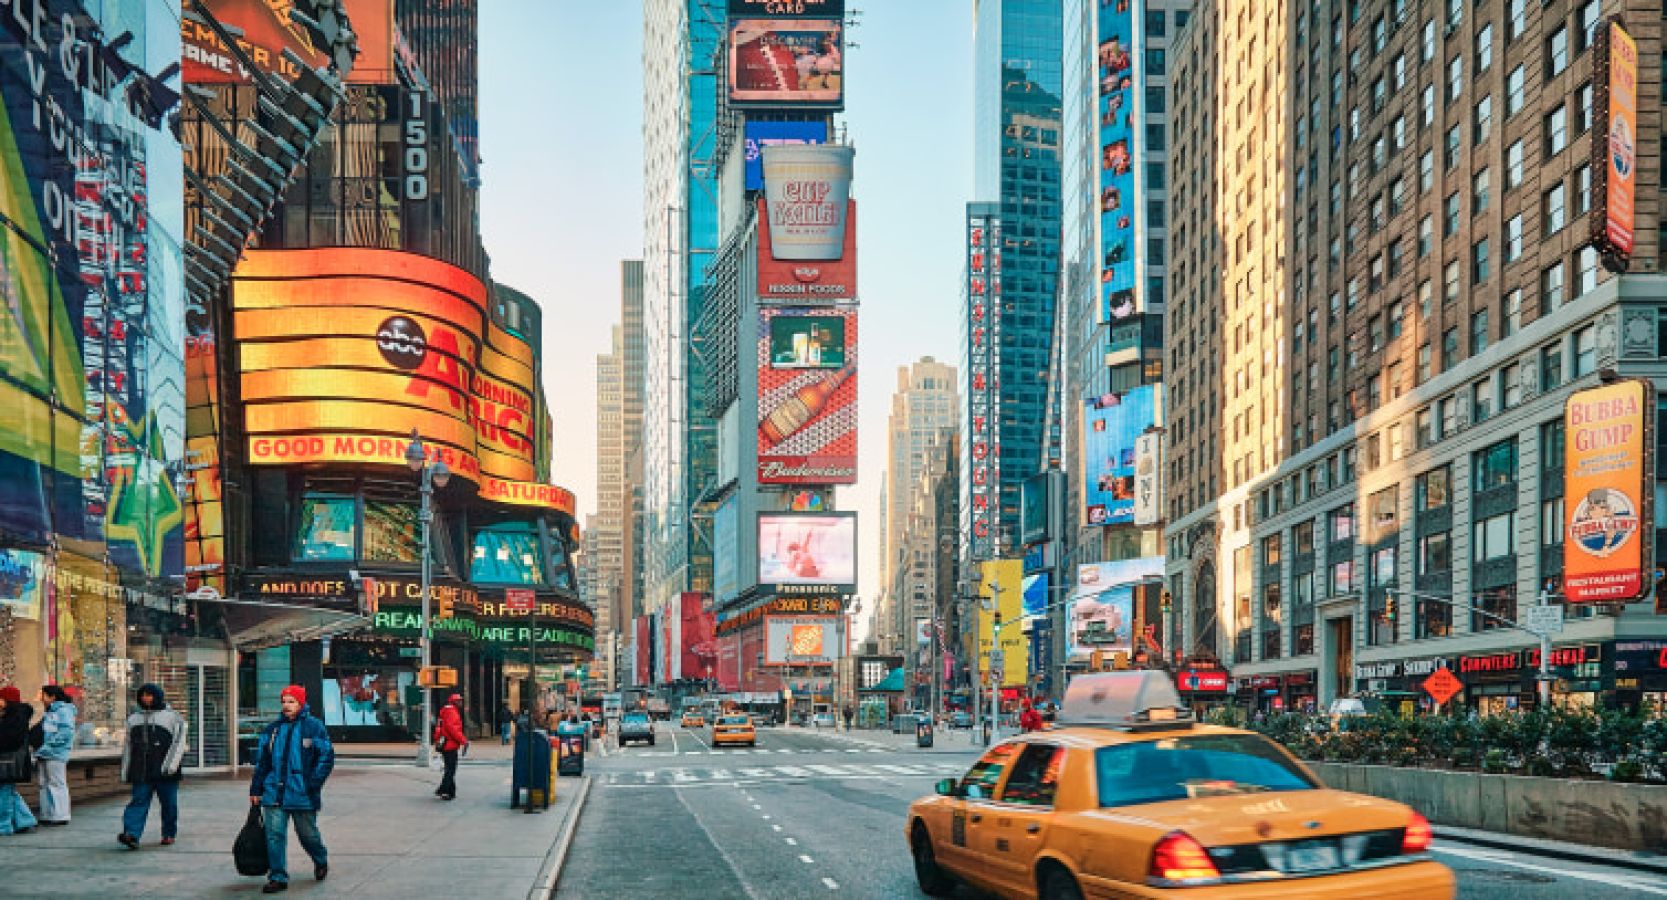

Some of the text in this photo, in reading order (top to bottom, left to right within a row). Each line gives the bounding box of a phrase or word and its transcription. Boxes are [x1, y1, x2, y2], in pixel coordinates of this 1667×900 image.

[766, 2, 805, 14] CARD
[406, 92, 428, 200] 1500
[1571, 395, 1637, 426] BUBBA
[253, 439, 325, 457] GOOD
[1575, 423, 1633, 451] GUMP
[776, 584, 838, 593] Panasonic
